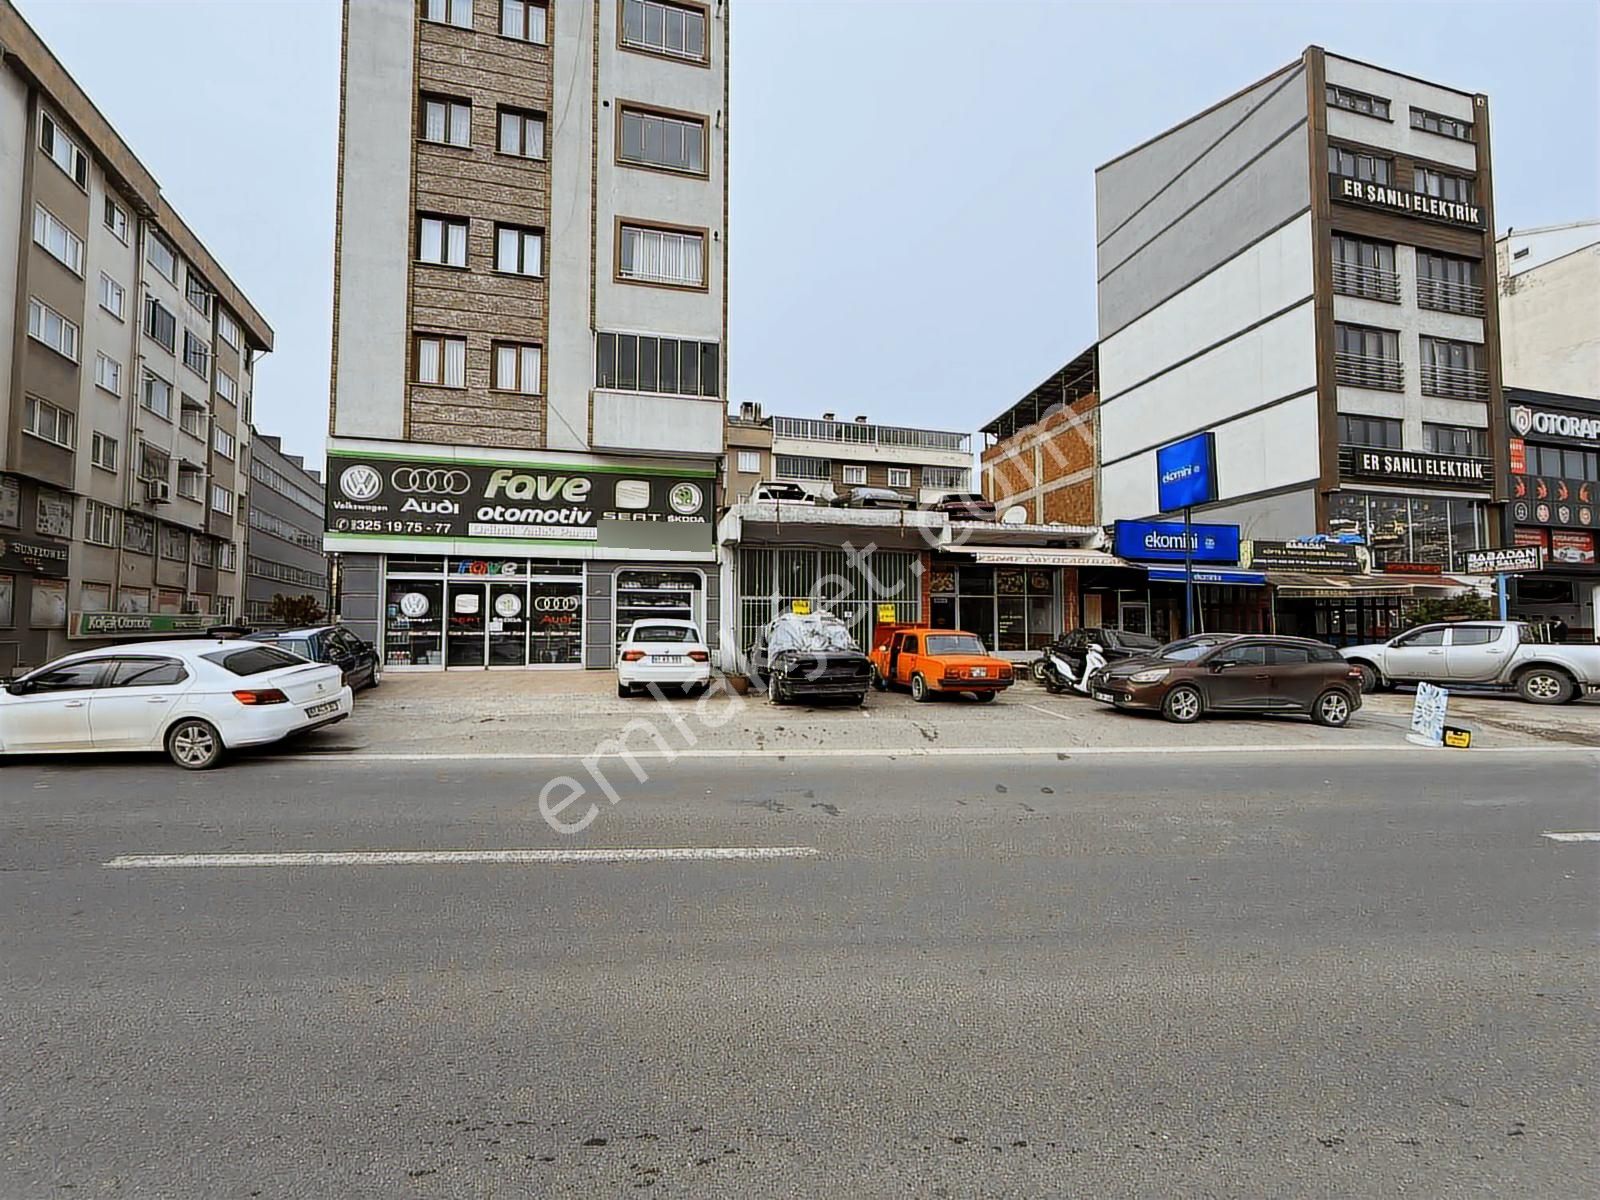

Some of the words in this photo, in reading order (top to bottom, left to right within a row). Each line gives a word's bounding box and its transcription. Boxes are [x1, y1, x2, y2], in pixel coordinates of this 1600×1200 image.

[1344, 179, 1362, 198] ER
[1367, 185, 1410, 209] ŞANLI
[1414, 195, 1479, 224] ELEKTRİK
[1162, 464, 1192, 484] ekomini
[1363, 453, 1379, 471] ER
[1384, 455, 1422, 474] ŞANLI
[1426, 459, 1484, 479] ELEKTRİK
[400, 497, 460, 514] Audi
[477, 505, 592, 525] otomotiv
[602, 511, 662, 521] SEAT
[357, 519, 381, 531] 325
[386, 521, 402, 533] 19
[406, 522, 422, 534] 75
[435, 523, 451, 534] 77
[1145, 530, 1199, 550] ekomini
[1468, 548, 1535, 562] BABADAN
